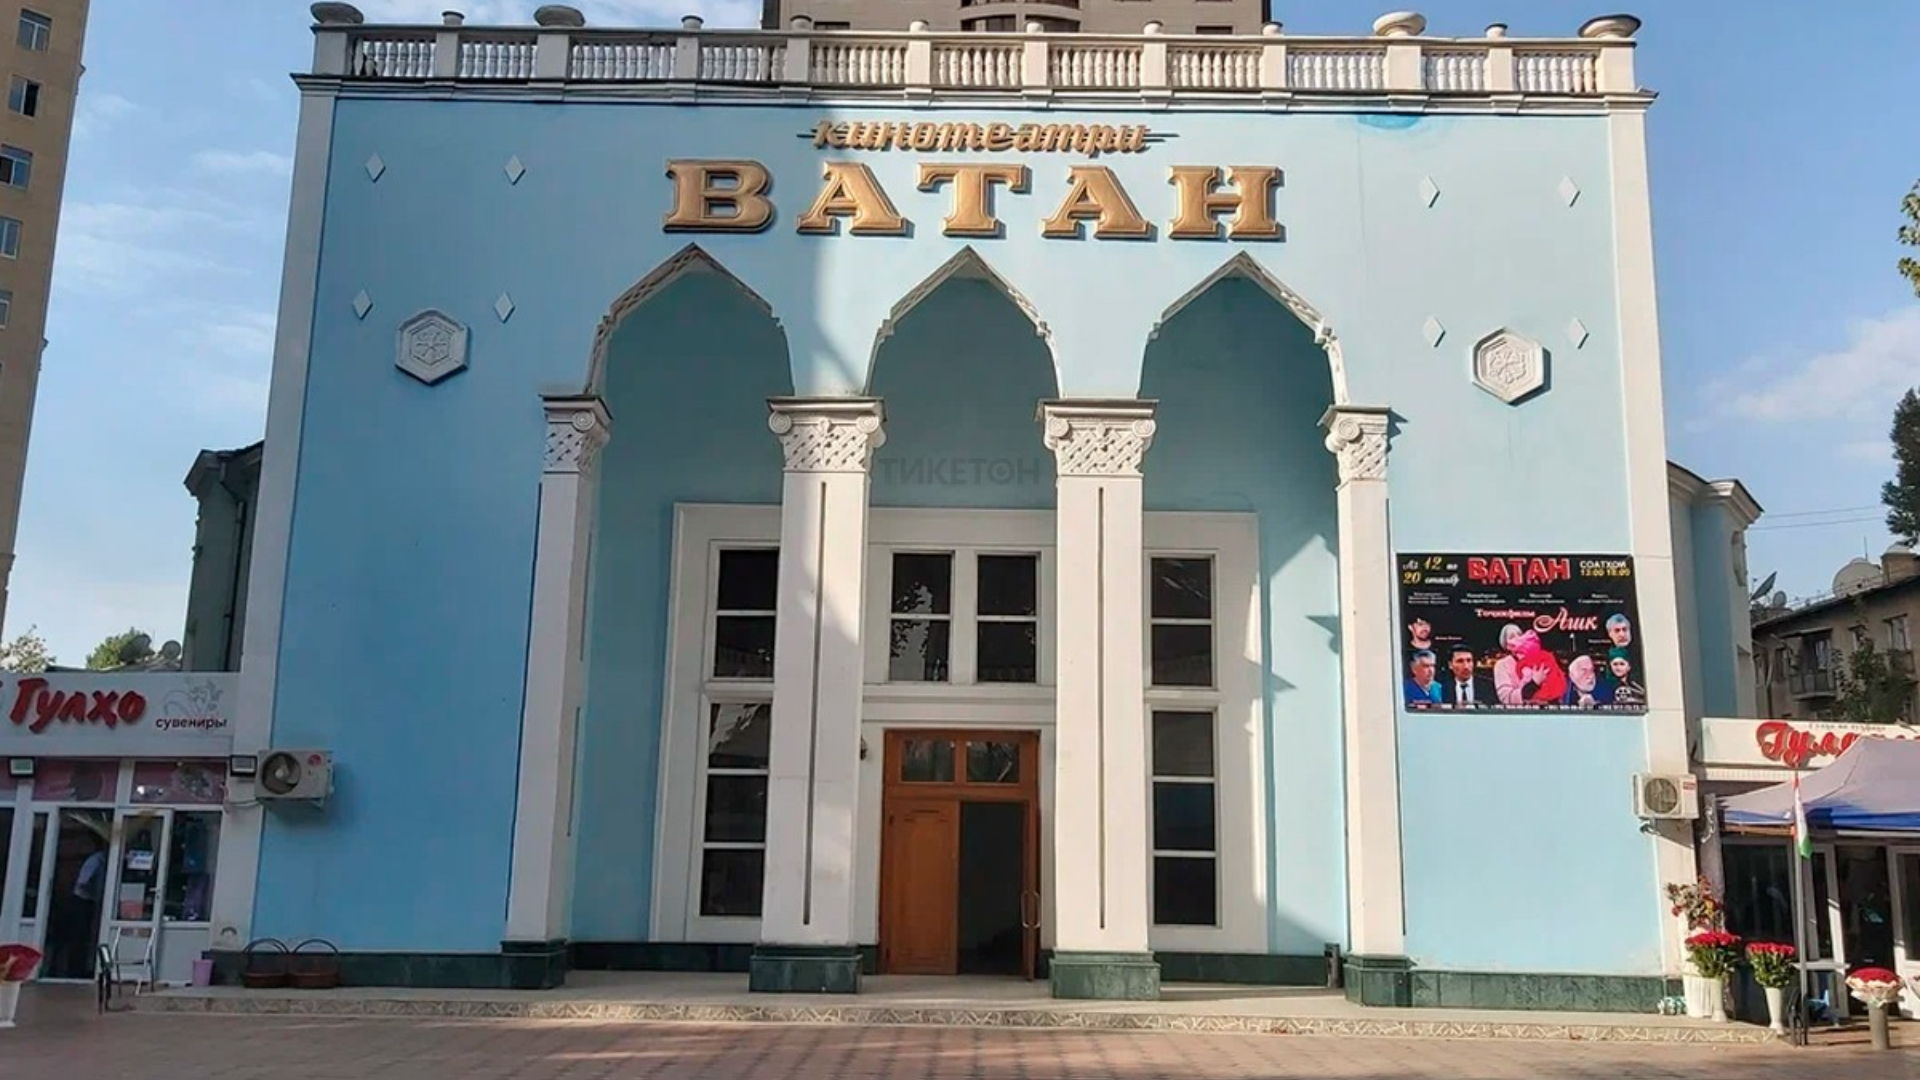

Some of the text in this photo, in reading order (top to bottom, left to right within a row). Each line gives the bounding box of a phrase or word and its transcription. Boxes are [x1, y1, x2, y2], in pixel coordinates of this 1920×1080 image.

[811, 120, 1147, 157] кинотеатри
[664, 160, 1285, 242] ВАТАН
[1402, 571, 1421, 584] 20
[1467, 557, 1570, 584] ВАТАН
[154, 717, 228, 730] сувениры
